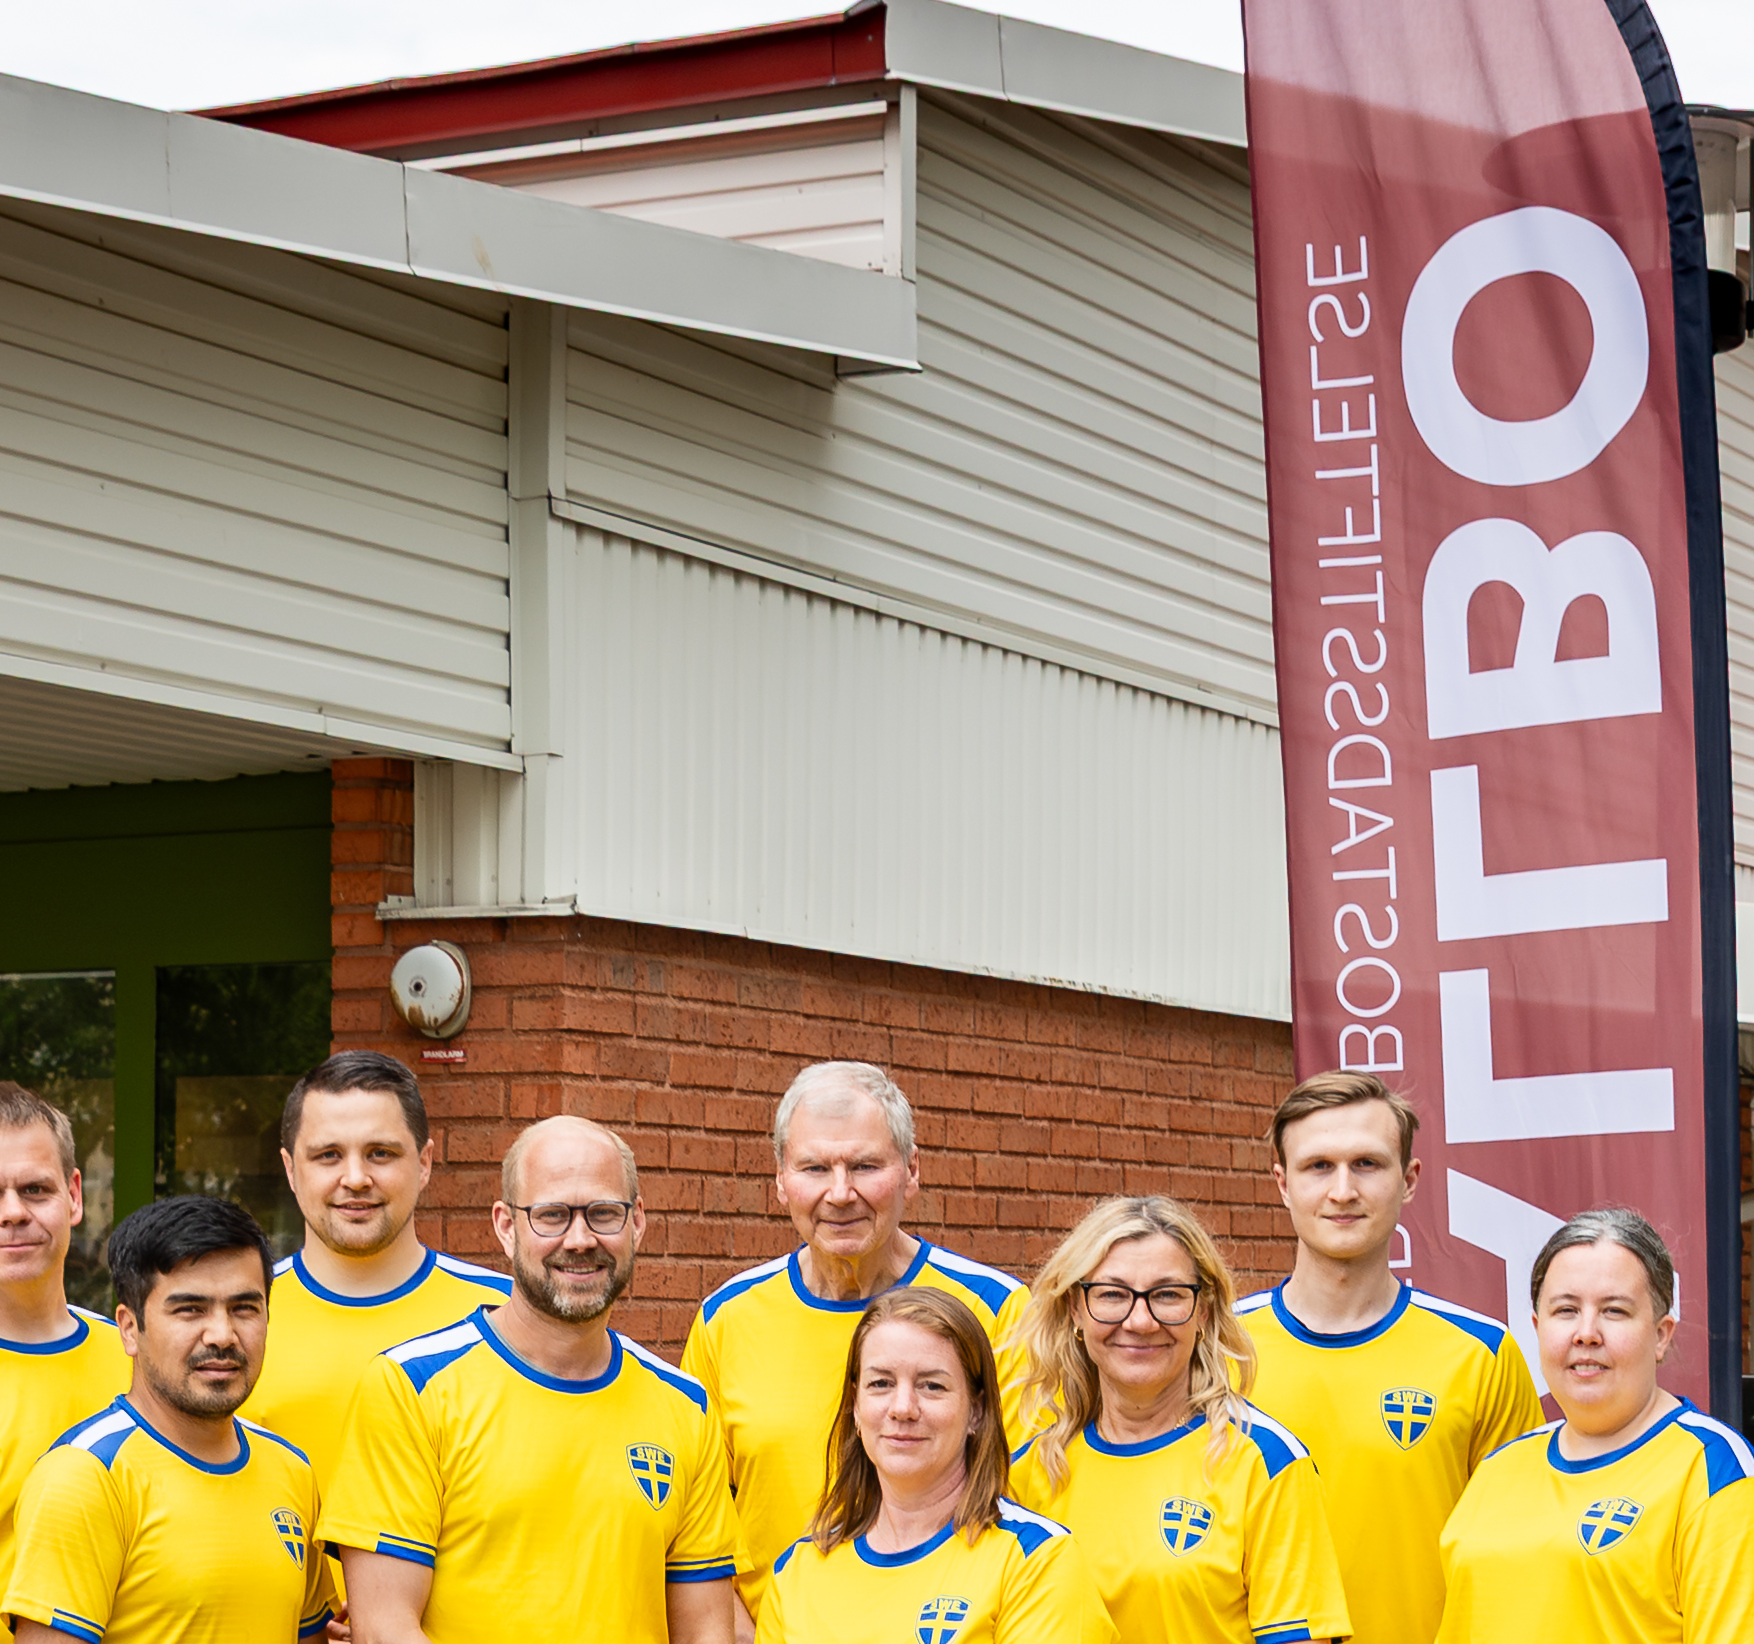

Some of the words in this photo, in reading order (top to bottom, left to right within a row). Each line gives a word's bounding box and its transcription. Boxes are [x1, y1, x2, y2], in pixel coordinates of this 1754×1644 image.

[1393, 1391, 1426, 1405] SWE
[636, 1447, 665, 1462] SWE
[1172, 1500, 1205, 1518] SWE
